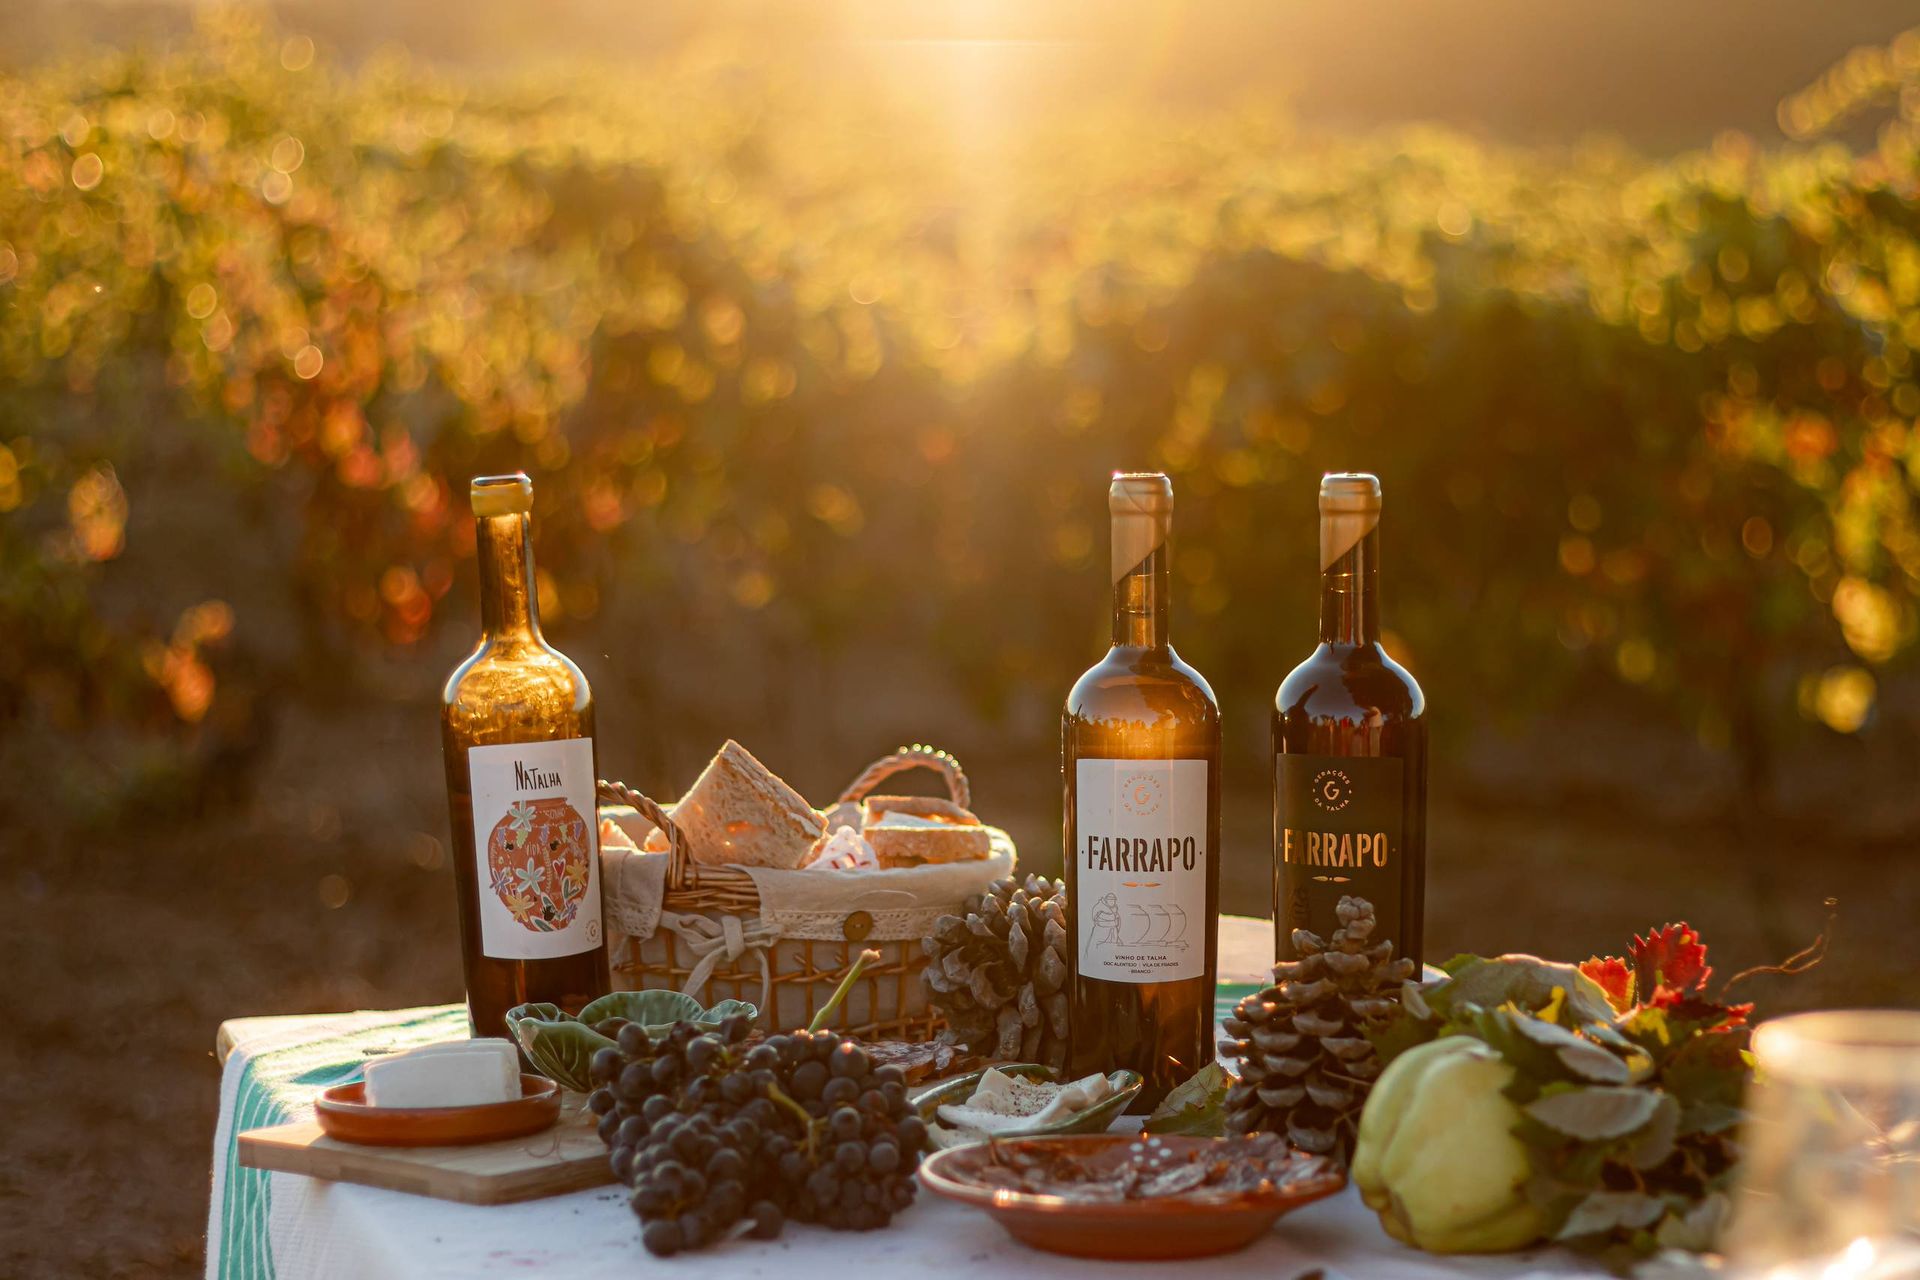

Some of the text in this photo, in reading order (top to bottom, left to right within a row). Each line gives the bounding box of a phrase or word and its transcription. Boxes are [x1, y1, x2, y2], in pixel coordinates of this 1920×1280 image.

[514, 760, 562, 791] NATALHA
[1324, 781, 1340, 801] G
[1326, 800, 1349, 811] TALHA
[1087, 835, 1196, 872] FARRAPO
[1284, 828, 1388, 868] FARRAPO
